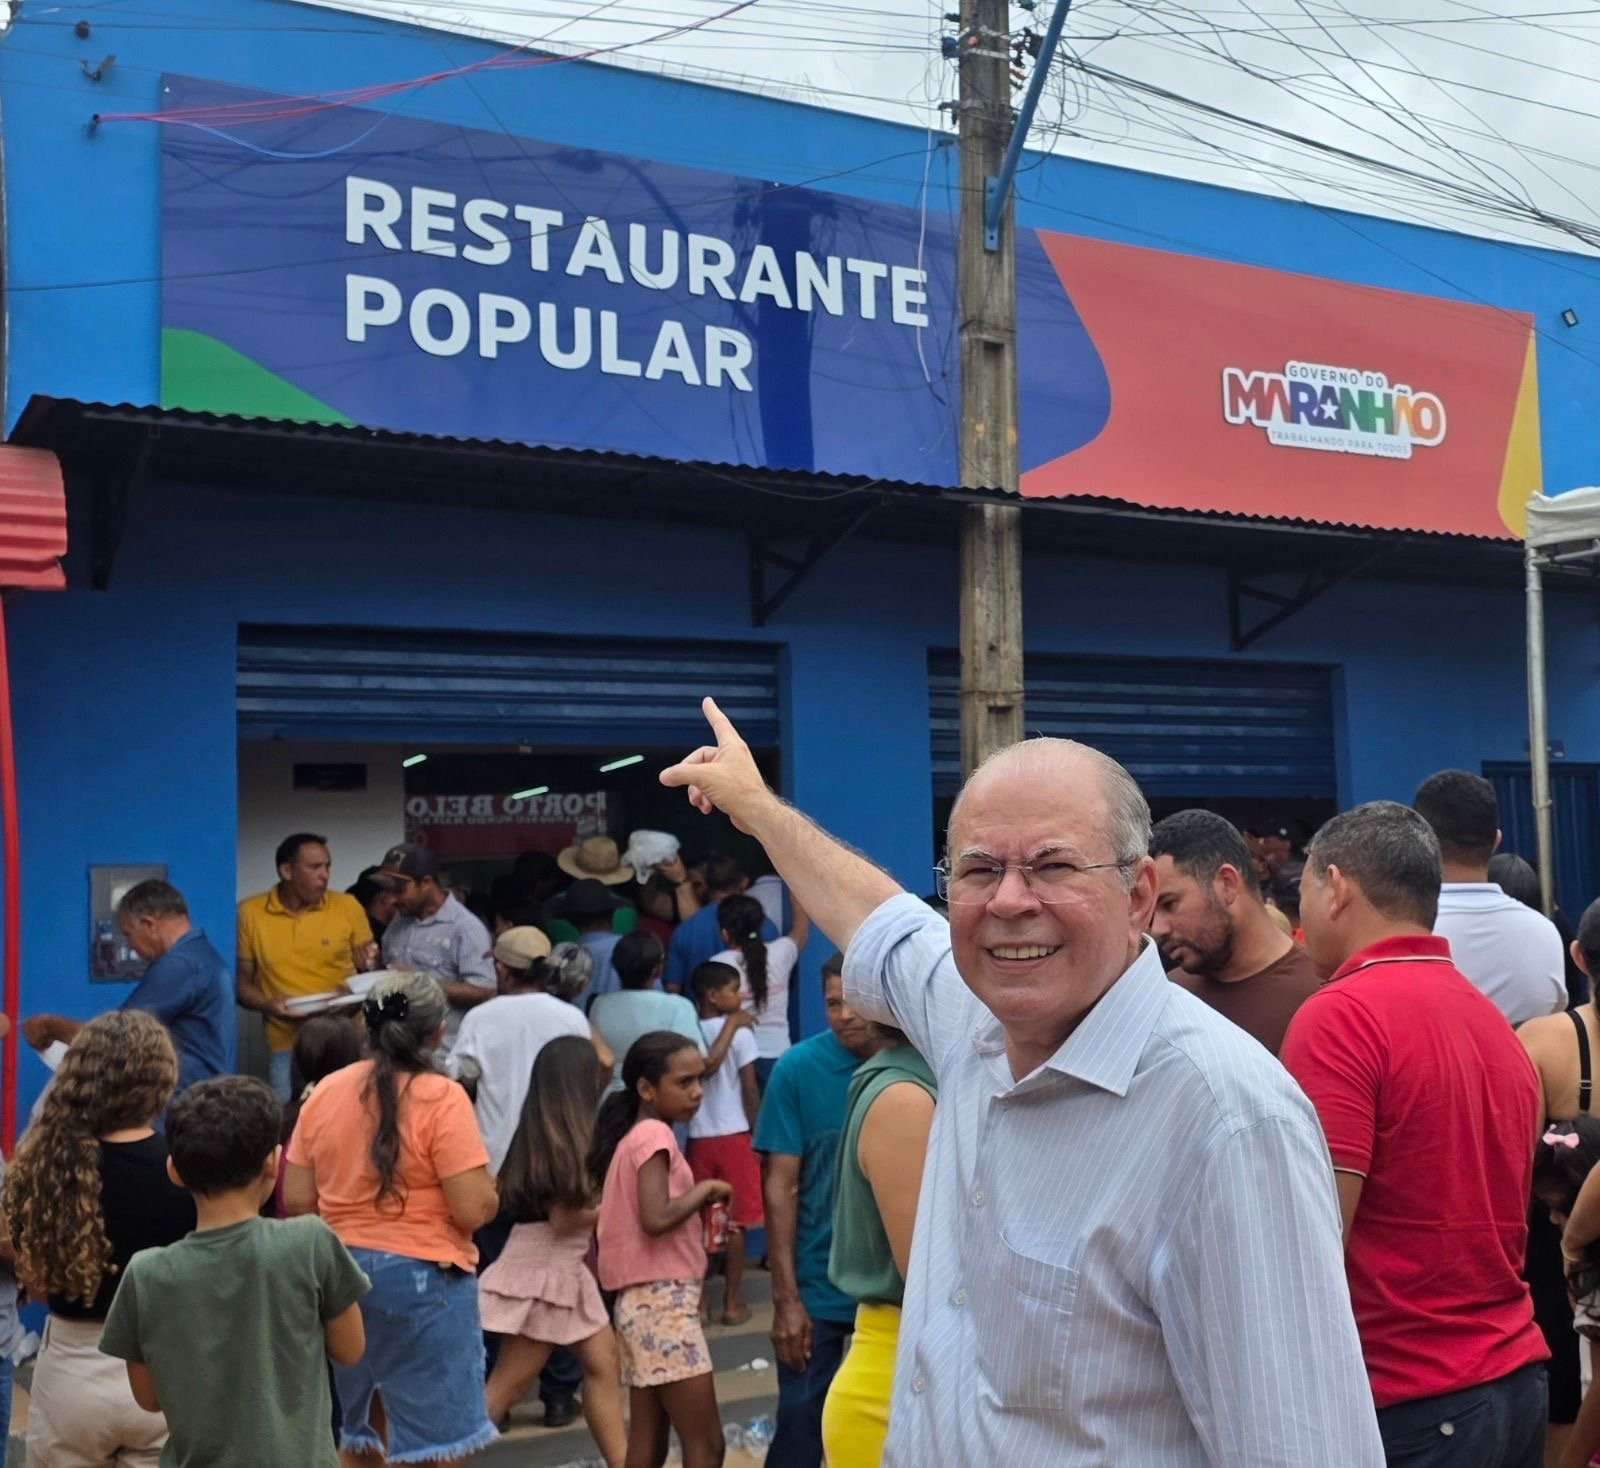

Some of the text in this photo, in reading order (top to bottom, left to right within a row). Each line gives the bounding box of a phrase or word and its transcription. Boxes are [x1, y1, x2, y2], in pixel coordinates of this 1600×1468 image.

[346, 176, 929, 328] RESTAURANTE
[346, 274, 753, 392] POPULAR
[1227, 372, 1441, 440] MARANHÃO
[1289, 364, 1384, 388] GOVERNO DO
[1272, 430, 1409, 454] TRABALHANDO PARA TODOS
